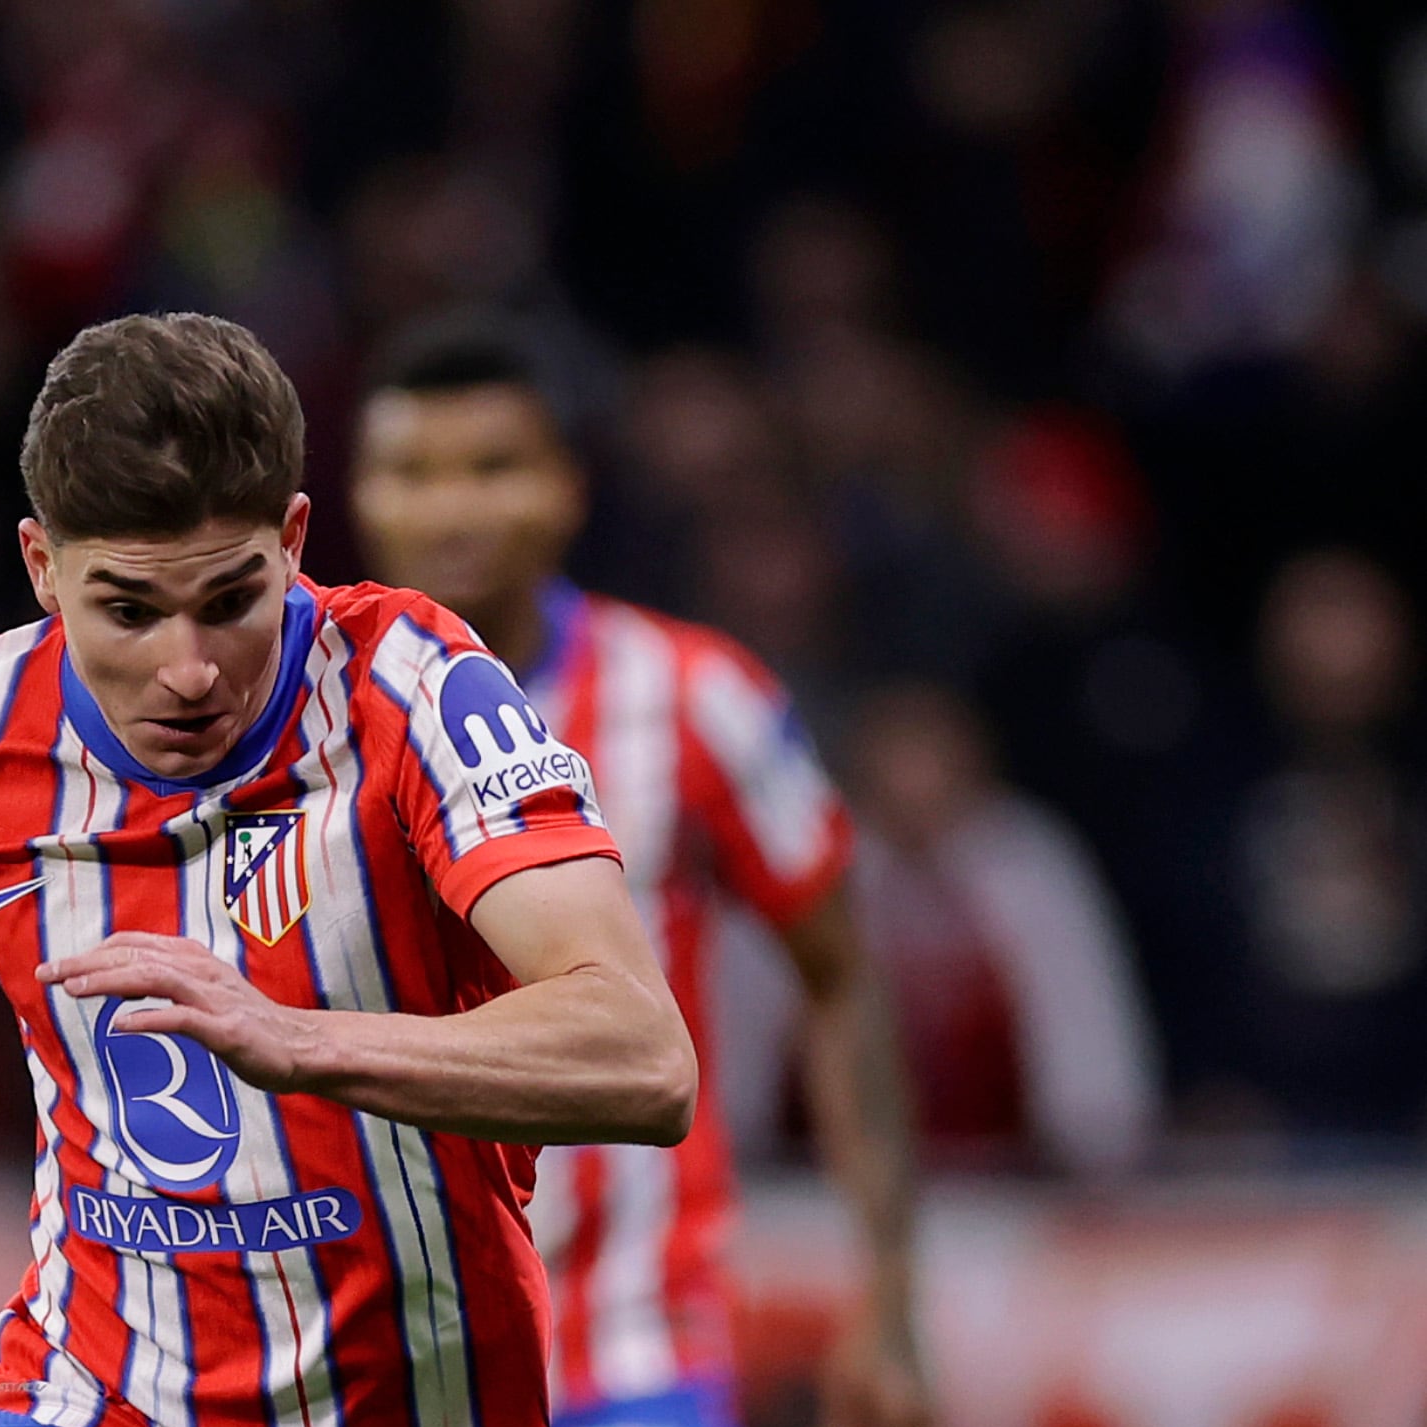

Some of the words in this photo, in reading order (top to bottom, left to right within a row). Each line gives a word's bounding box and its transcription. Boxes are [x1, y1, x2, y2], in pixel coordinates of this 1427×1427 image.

[473, 753, 586, 807] kraken
[76, 1191, 246, 1246] RIYADH
[261, 1195, 350, 1246] AIR
